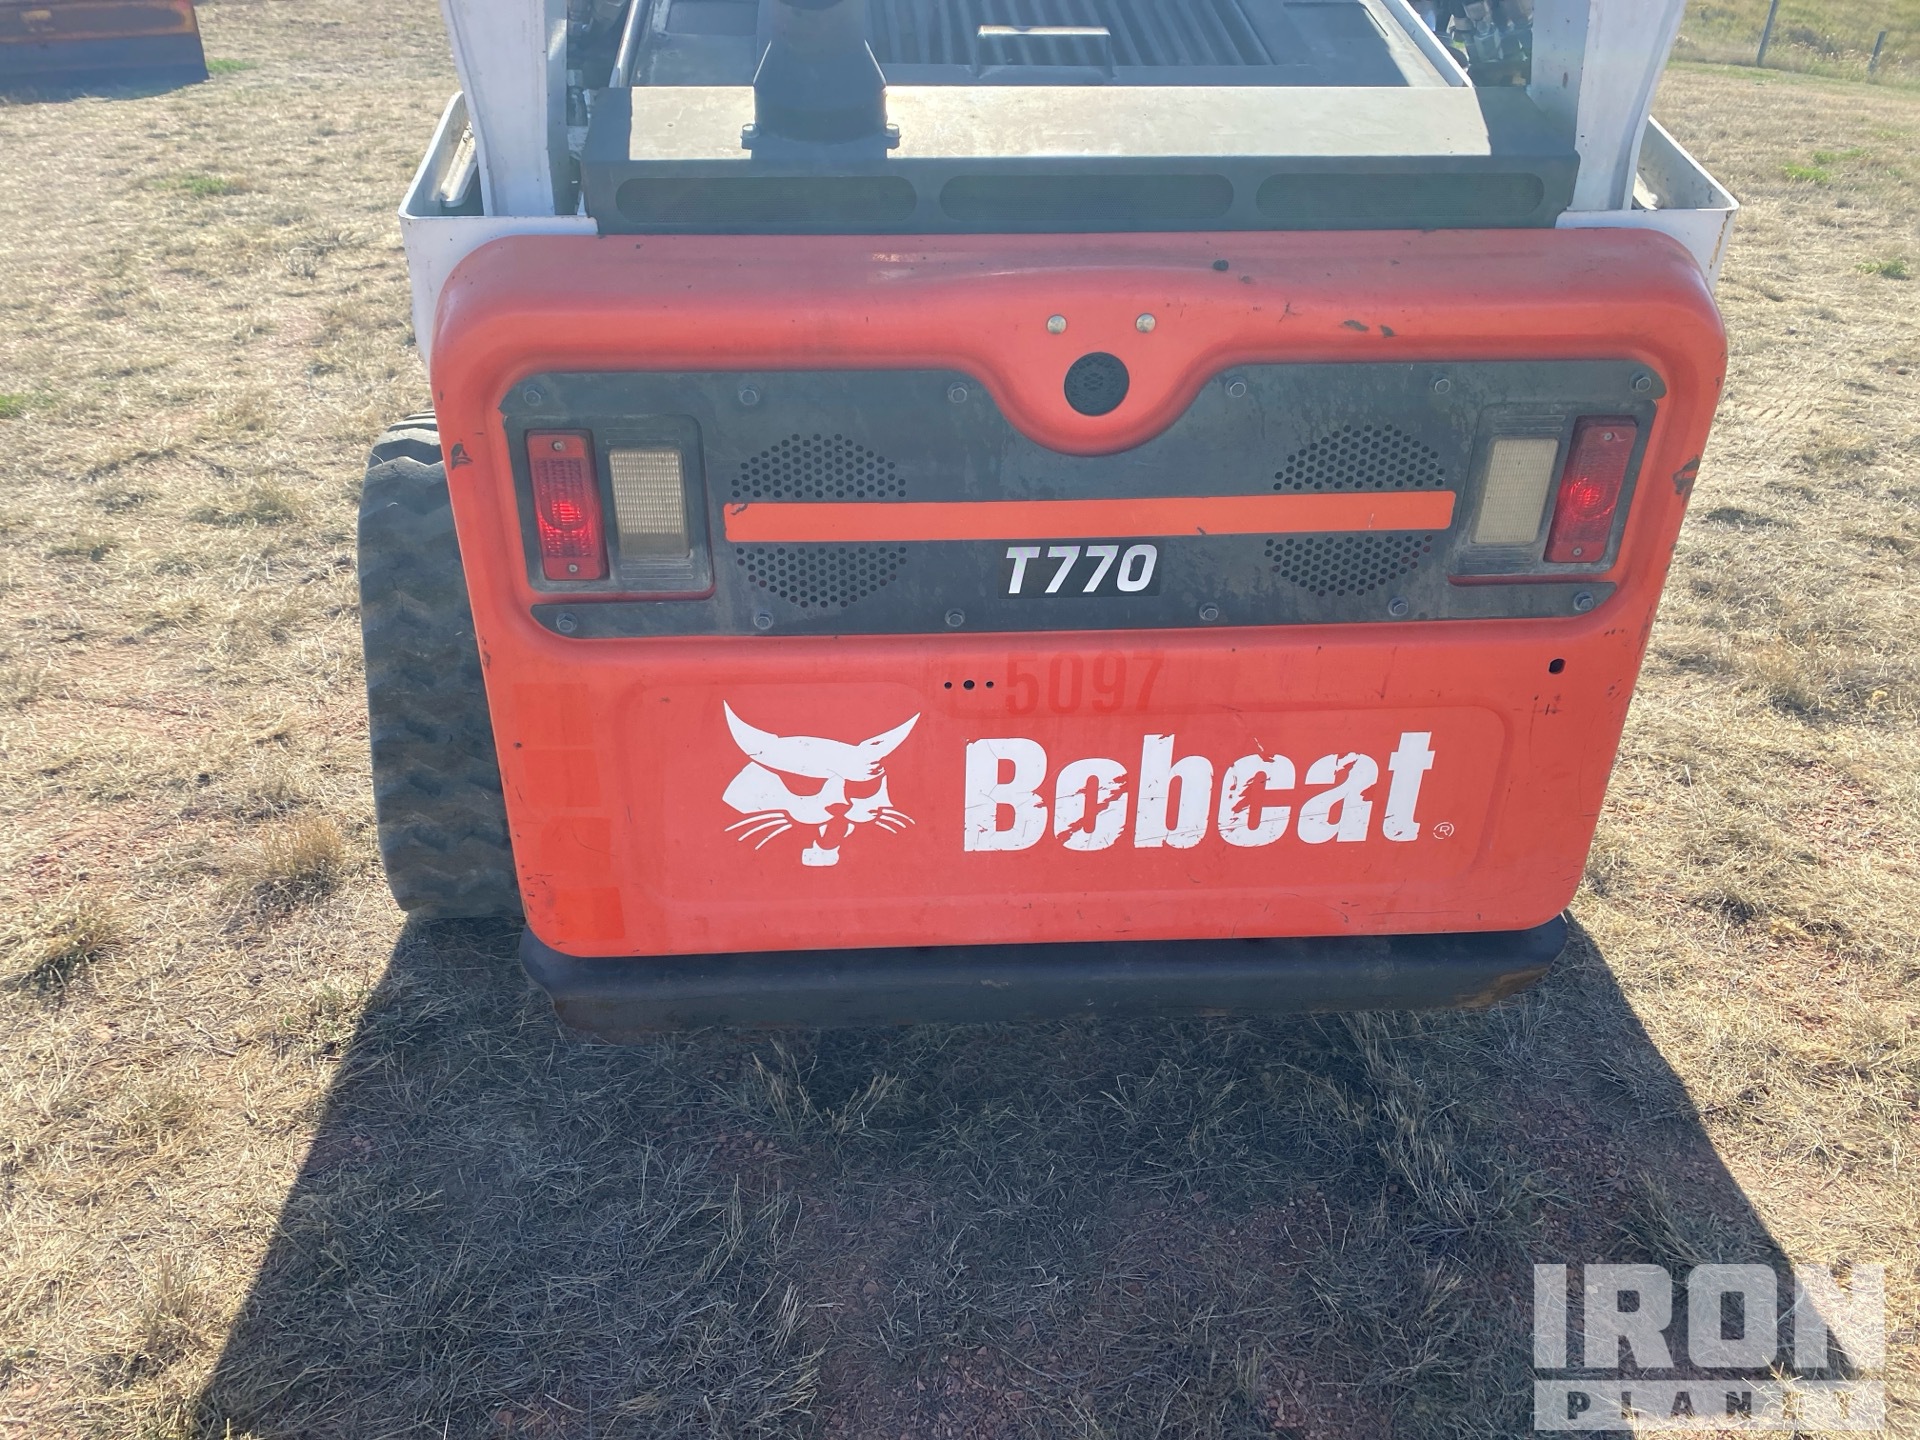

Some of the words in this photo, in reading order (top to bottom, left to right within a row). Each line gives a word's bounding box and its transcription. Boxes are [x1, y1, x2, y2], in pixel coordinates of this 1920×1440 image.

[1006, 544, 1158, 595] T770
[1005, 650, 1166, 716] 5097
[963, 731, 1436, 852] Bobcat
